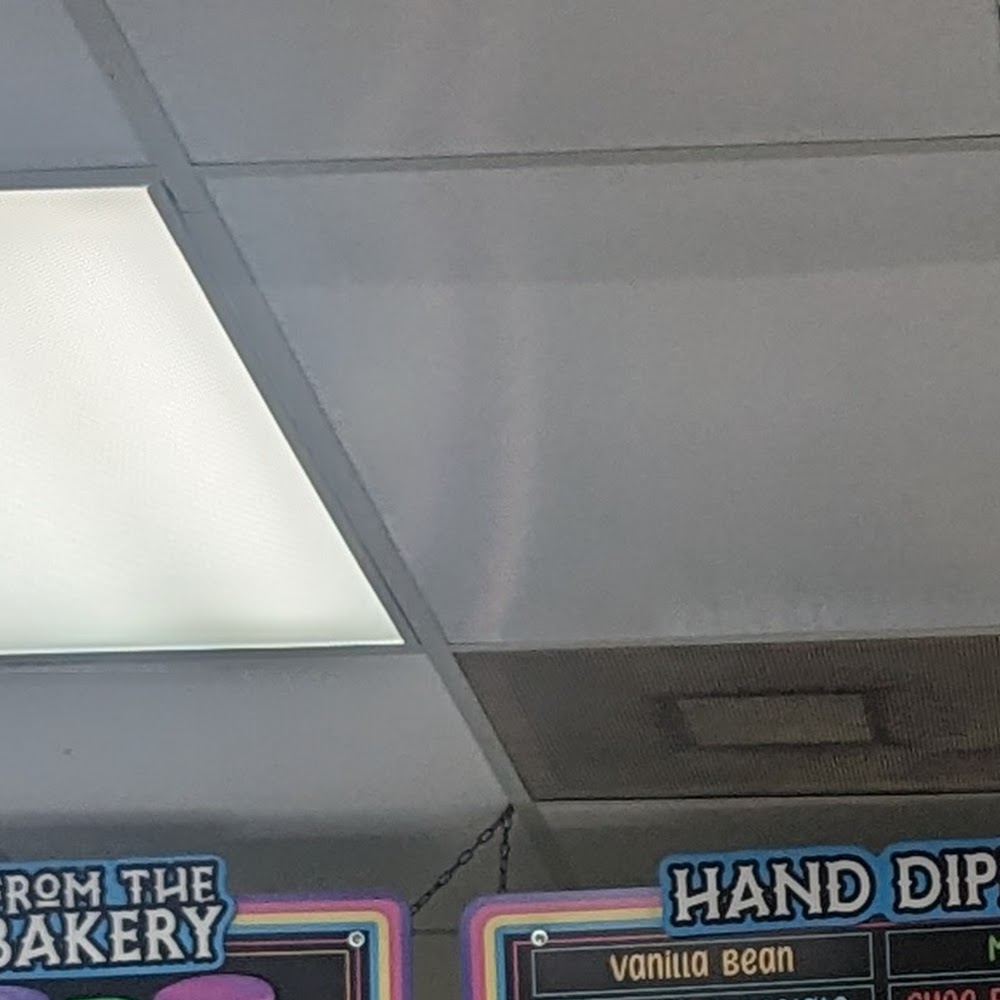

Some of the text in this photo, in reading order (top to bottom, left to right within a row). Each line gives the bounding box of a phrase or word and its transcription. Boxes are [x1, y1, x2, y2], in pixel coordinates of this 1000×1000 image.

[0, 867, 215, 915] ROM THE
[672, 859, 872, 922] HAND
[609, 945, 795, 982] Vanilla Bean
